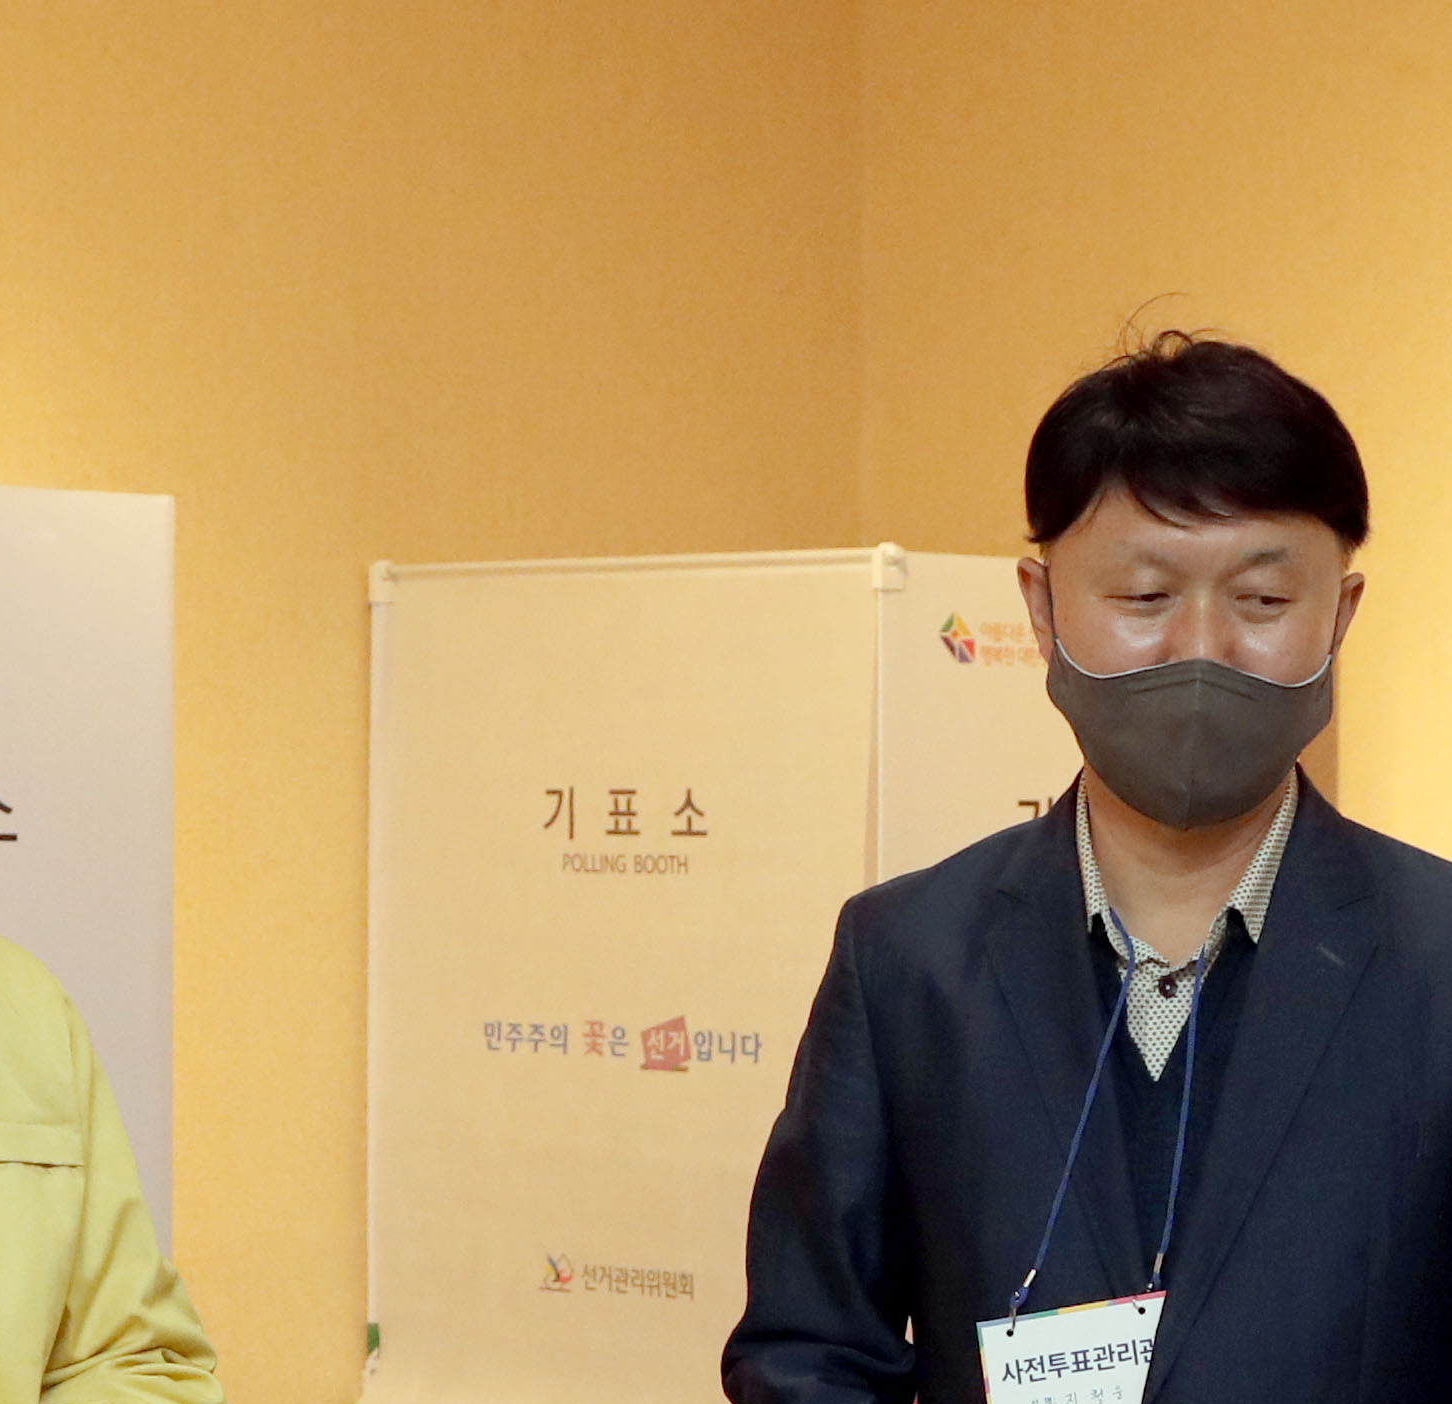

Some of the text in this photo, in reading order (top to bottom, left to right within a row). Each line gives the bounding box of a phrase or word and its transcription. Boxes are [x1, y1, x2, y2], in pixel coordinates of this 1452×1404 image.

[562, 853, 689, 875] POLLING BOOTH
[484, 1021, 568, 1055] 민주주의
[582, 1020, 629, 1057] 꽃은
[581, 1264, 695, 1300] 선거관리위원회
